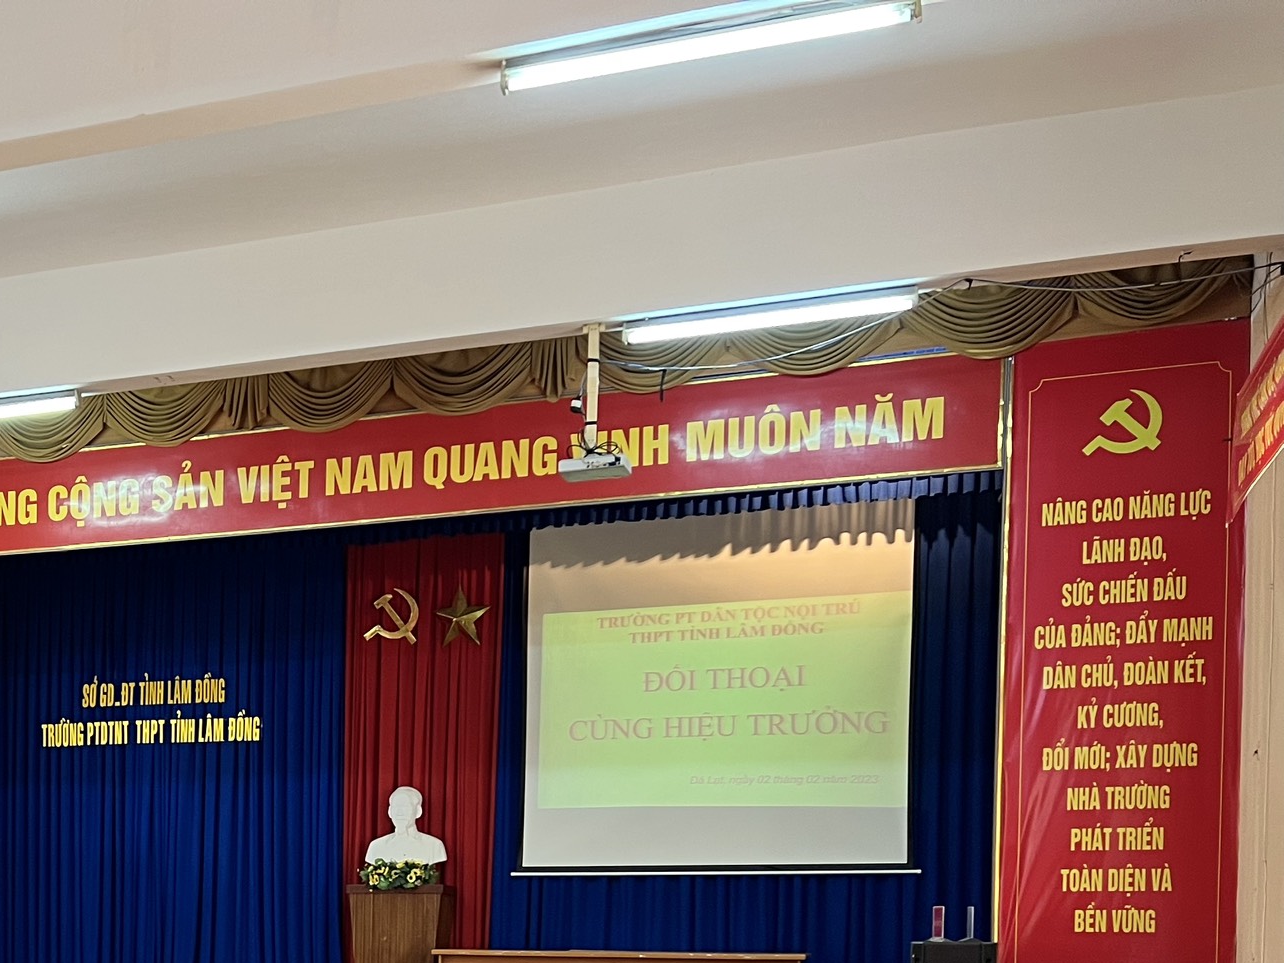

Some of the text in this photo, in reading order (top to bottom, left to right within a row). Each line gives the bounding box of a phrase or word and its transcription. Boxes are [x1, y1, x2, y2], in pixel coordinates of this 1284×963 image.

[47, 475, 140, 528] CỘNG
[151, 460, 225, 514] SẢN
[236, 455, 315, 509] VIỆT
[324, 444, 414, 496] NAM
[423, 435, 558, 489] QUANG
[686, 404, 821, 461] MUÔN
[833, 392, 945, 448] NĂM
[1041, 489, 1211, 527] NÂNG CAO NĂNG LỰC
[1082, 535, 1167, 566] LÃNH ĐẠO,
[1061, 568, 1187, 607] SỨC CHIẾN ĐẤU
[628, 630, 674, 644] THPT
[1034, 610, 1213, 649] CỦA ĐẢNG; ĐẨY MẠNH
[643, 663, 807, 693] ĐỐI THOẠI
[1042, 651, 1207, 689] DÂN CHỦ, ĐOÀN KẾT,
[82, 675, 98, 708] SỞ
[139, 673, 164, 705] TỈNH
[167, 676, 192, 704] LÂM
[195, 672, 226, 704] ĐỒNG
[41, 709, 260, 748] TRƯỜNG PTDTNT THPT TỈNH LÂM ĐỒNG
[568, 704, 890, 742] CÙNG HIỆU TRƯỞNG
[1077, 697, 1164, 729] KỶ CƯƠNG,
[1042, 737, 1198, 773] ĐỔI MỚI; XÂY DỰNG
[1067, 780, 1170, 811] NHÀ TRƯỜNG
[1070, 817, 1164, 851] PHÁT TRIỂN
[1060, 863, 1172, 897] TOÀN DIỆN VÀ
[1074, 902, 1156, 933] BỀN VỮNG
